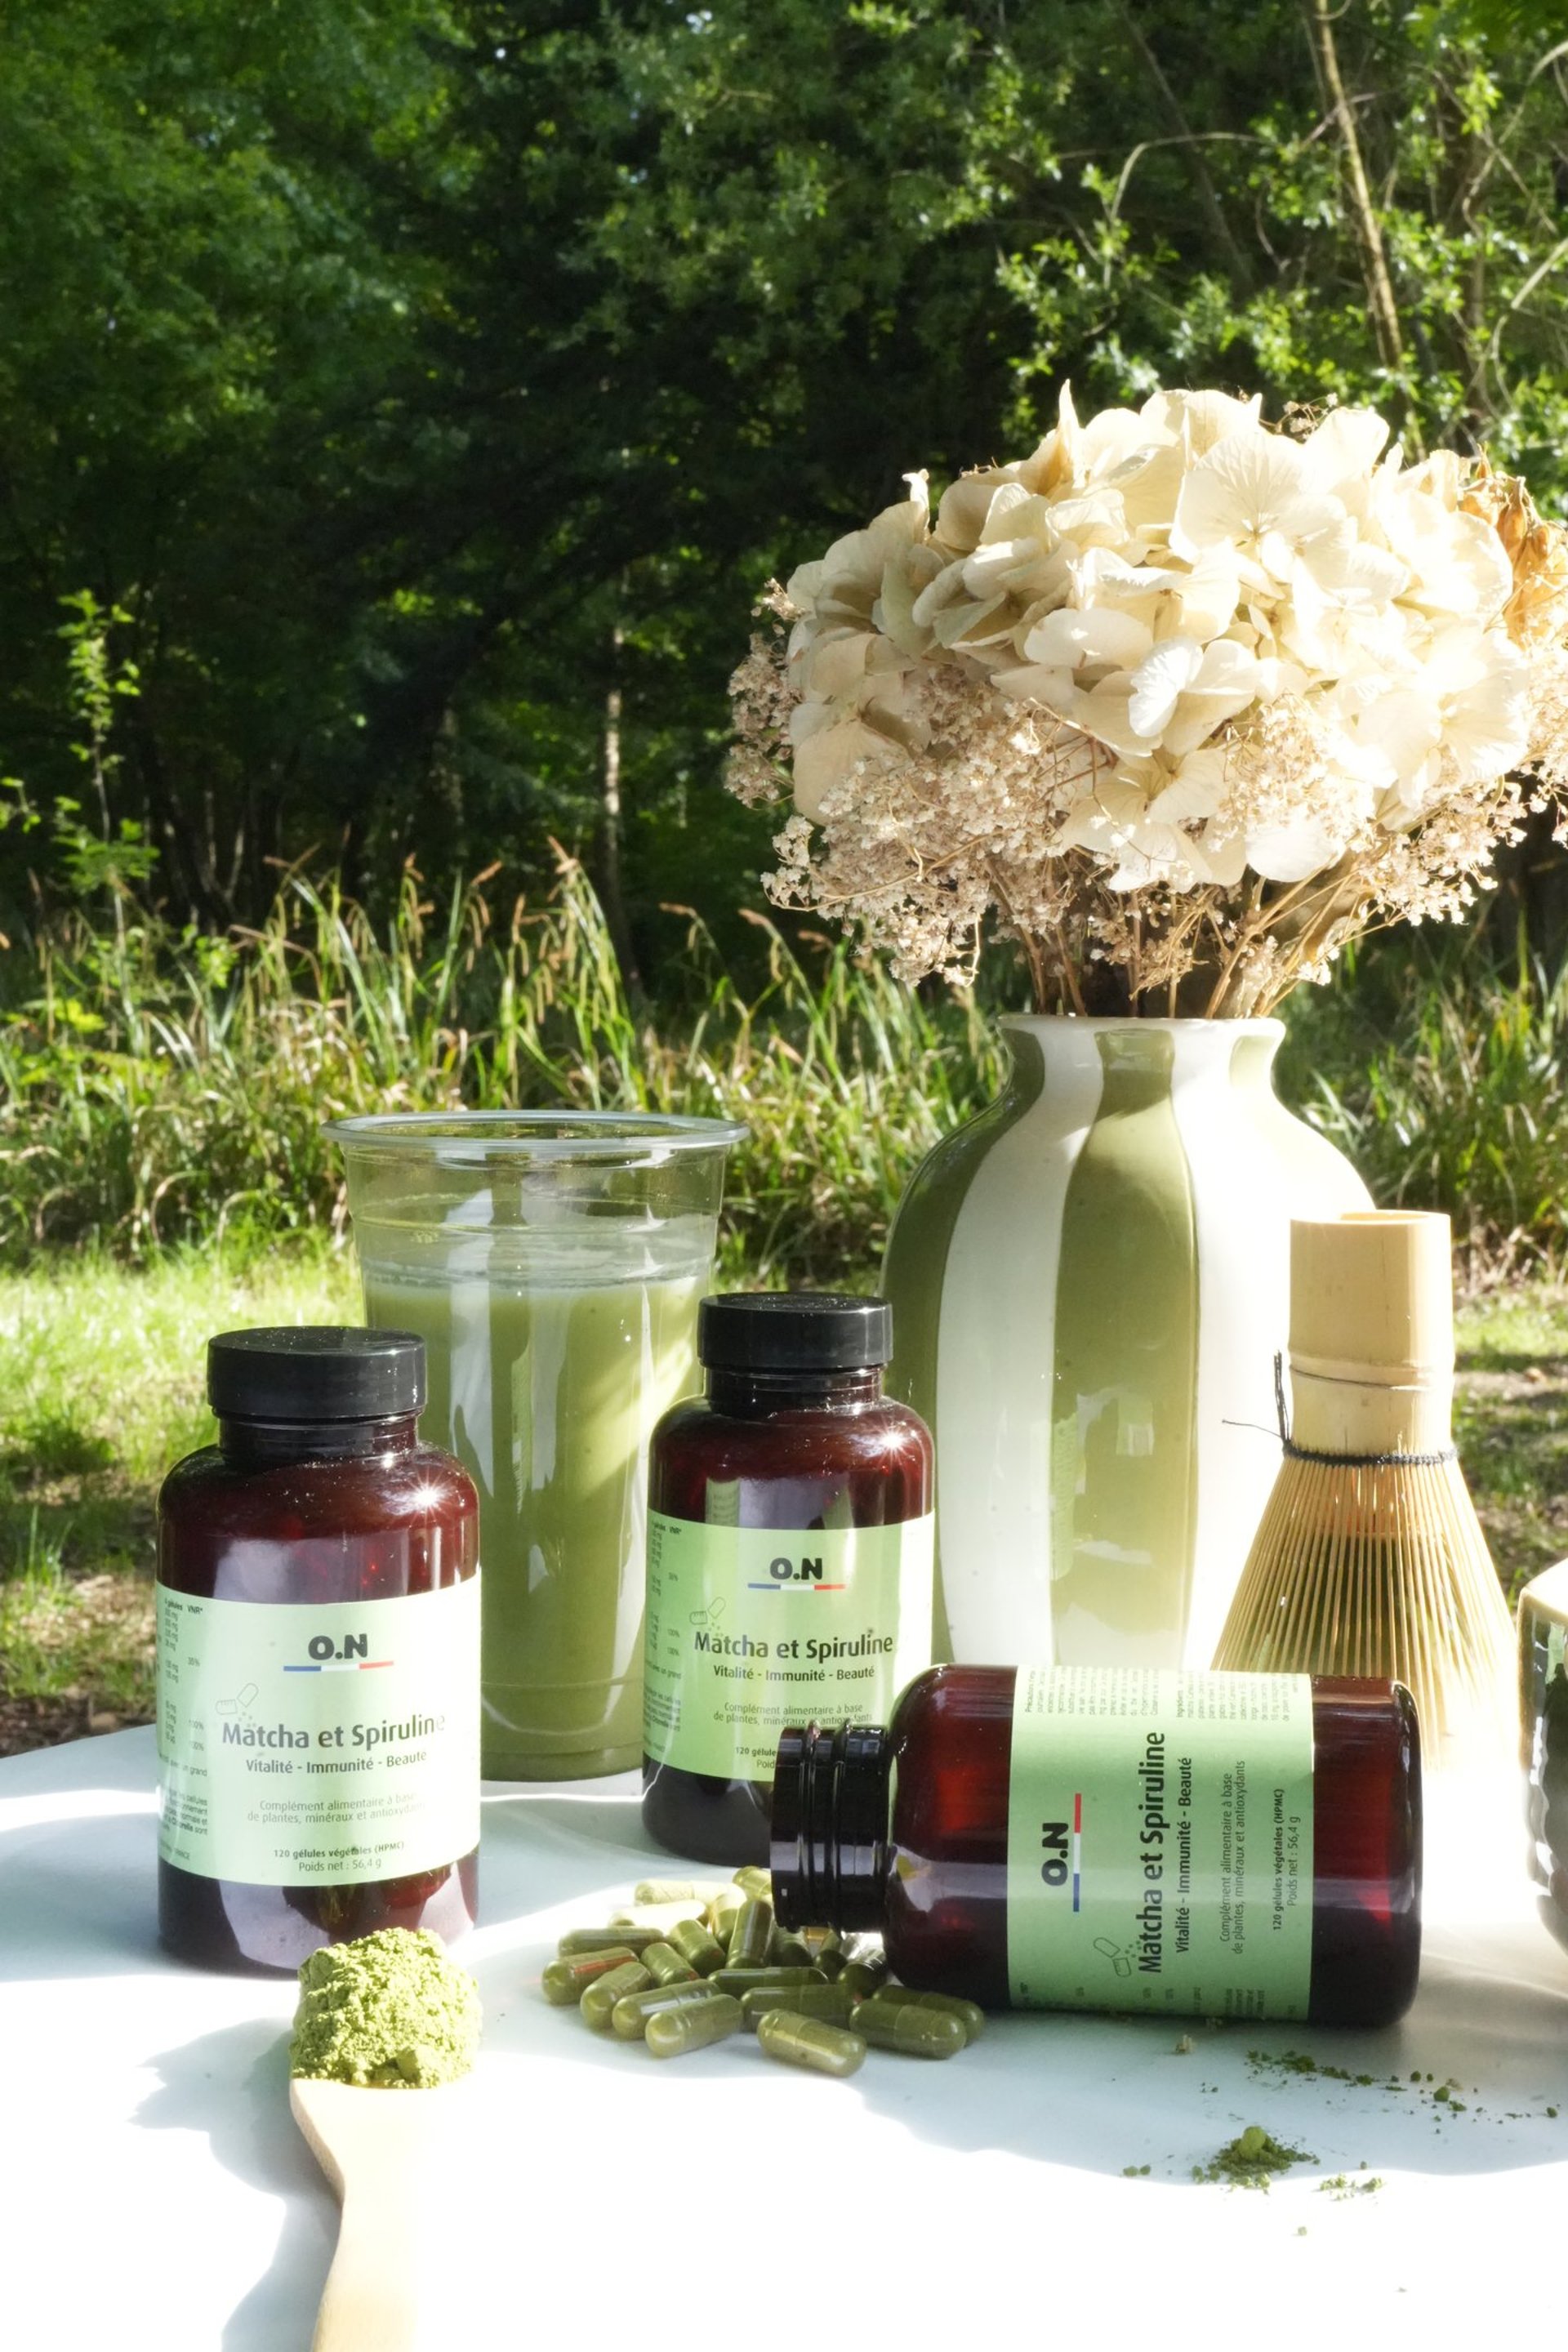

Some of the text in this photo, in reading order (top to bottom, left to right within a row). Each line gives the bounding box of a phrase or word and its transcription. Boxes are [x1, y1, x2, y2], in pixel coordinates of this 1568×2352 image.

[769, 1557, 822, 1580] O.N
[308, 1633, 368, 1659] O.N
[694, 1632, 893, 1664] Matcha et Spiruline
[714, 1665, 754, 1679] Vitalité
[766, 1669, 825, 1682] Immunité
[836, 1666, 875, 1680] Beauté
[714, 1711, 724, 1722] de
[726, 1713, 760, 1725] plantes,
[764, 1717, 806, 1726] minéraux
[724, 1702, 780, 1715] Complément
[783, 1705, 834, 1716] alimentaire
[844, 1704, 863, 1713] base
[222, 1722, 310, 1748] Matcha
[318, 1726, 344, 1748] et
[352, 1714, 445, 1751] Spiruline
[736, 1747, 777, 1757] 120 gélule
[757, 1758, 775, 1769] Poid
[246, 1759, 293, 1774] Vitalité
[306, 1757, 374, 1775] Immunité
[1178, 1757, 1192, 1806] Beauté
[1220, 1772, 1232, 1797] base
[260, 1799, 324, 1813] Complément
[327, 1797, 384, 1811] alimentaire
[247, 1811, 260, 1821] de
[262, 1813, 301, 1824] plantes,
[305, 1812, 353, 1823] minéraux
[357, 1811, 367, 1820] et
[1289, 1815, 1302, 1824] g
[1220, 1811, 1232, 1873] alimentaire
[1287, 1826, 1301, 1849] 56,4
[274, 1849, 290, 1858] 120
[293, 1848, 326, 1860] gélules
[375, 1841, 404, 1854] (HPMC)
[1041, 1823, 1069, 1886] O.N
[1136, 1731, 1170, 1973] Matcha et Spiruline
[1177, 1821, 1192, 1893] Immunité
[1232, 1760, 1248, 1954] de plantes, minéraux et antioxydants
[1272, 1788, 1285, 1931] 120 gélules végétales (HPMC)
[299, 1861, 325, 1872] Poids
[327, 1861, 344, 1871] net
[353, 1859, 372, 1870] 56,4
[375, 1859, 381, 1869] g
[1287, 1859, 1298, 1876] net
[1286, 1879, 1298, 1907] Poids
[1219, 1877, 1233, 1942] Complément
[1174, 1907, 1190, 1953] Vitalité
